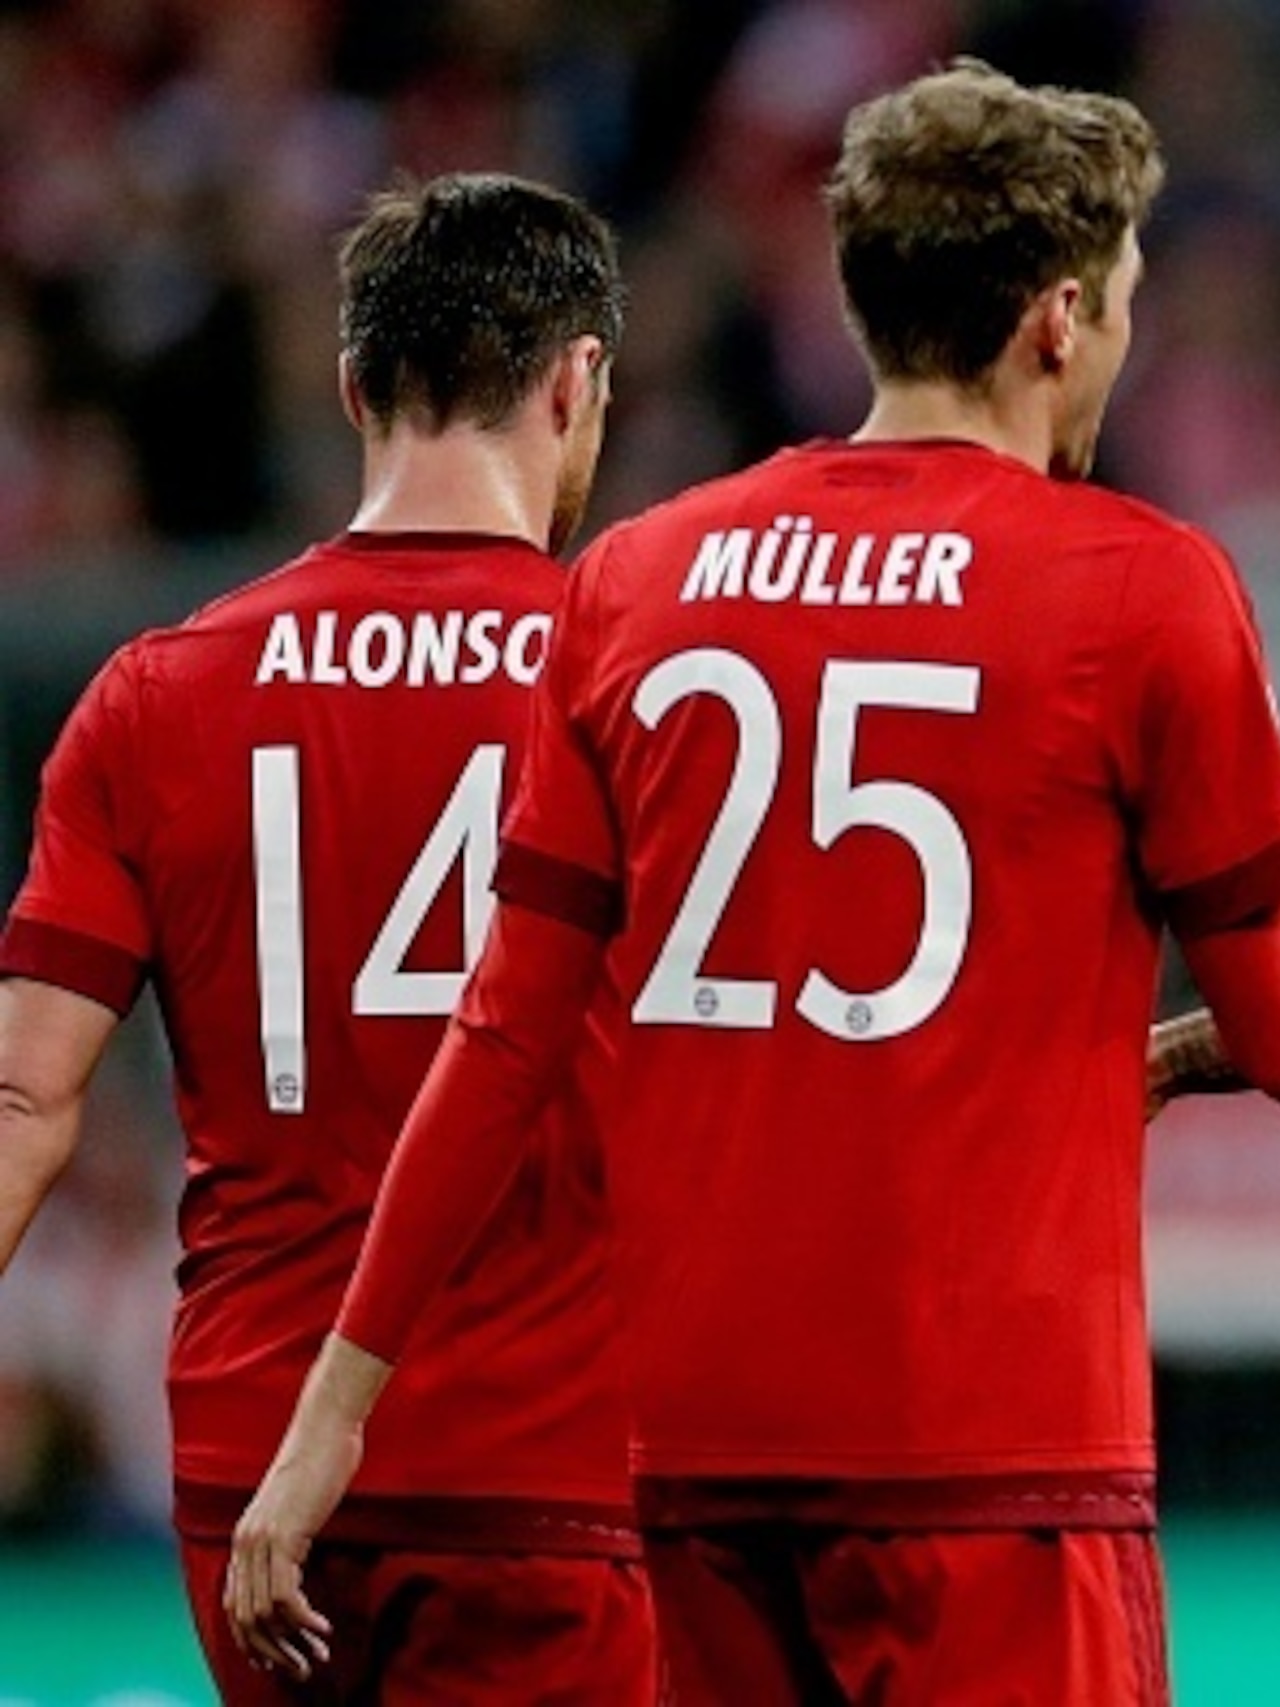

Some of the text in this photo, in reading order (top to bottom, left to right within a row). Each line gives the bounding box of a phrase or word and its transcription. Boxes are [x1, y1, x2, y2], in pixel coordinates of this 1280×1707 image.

[678, 516, 974, 606] MÜLLER
[251, 743, 506, 1114] 14
[630, 648, 982, 1041] 25
